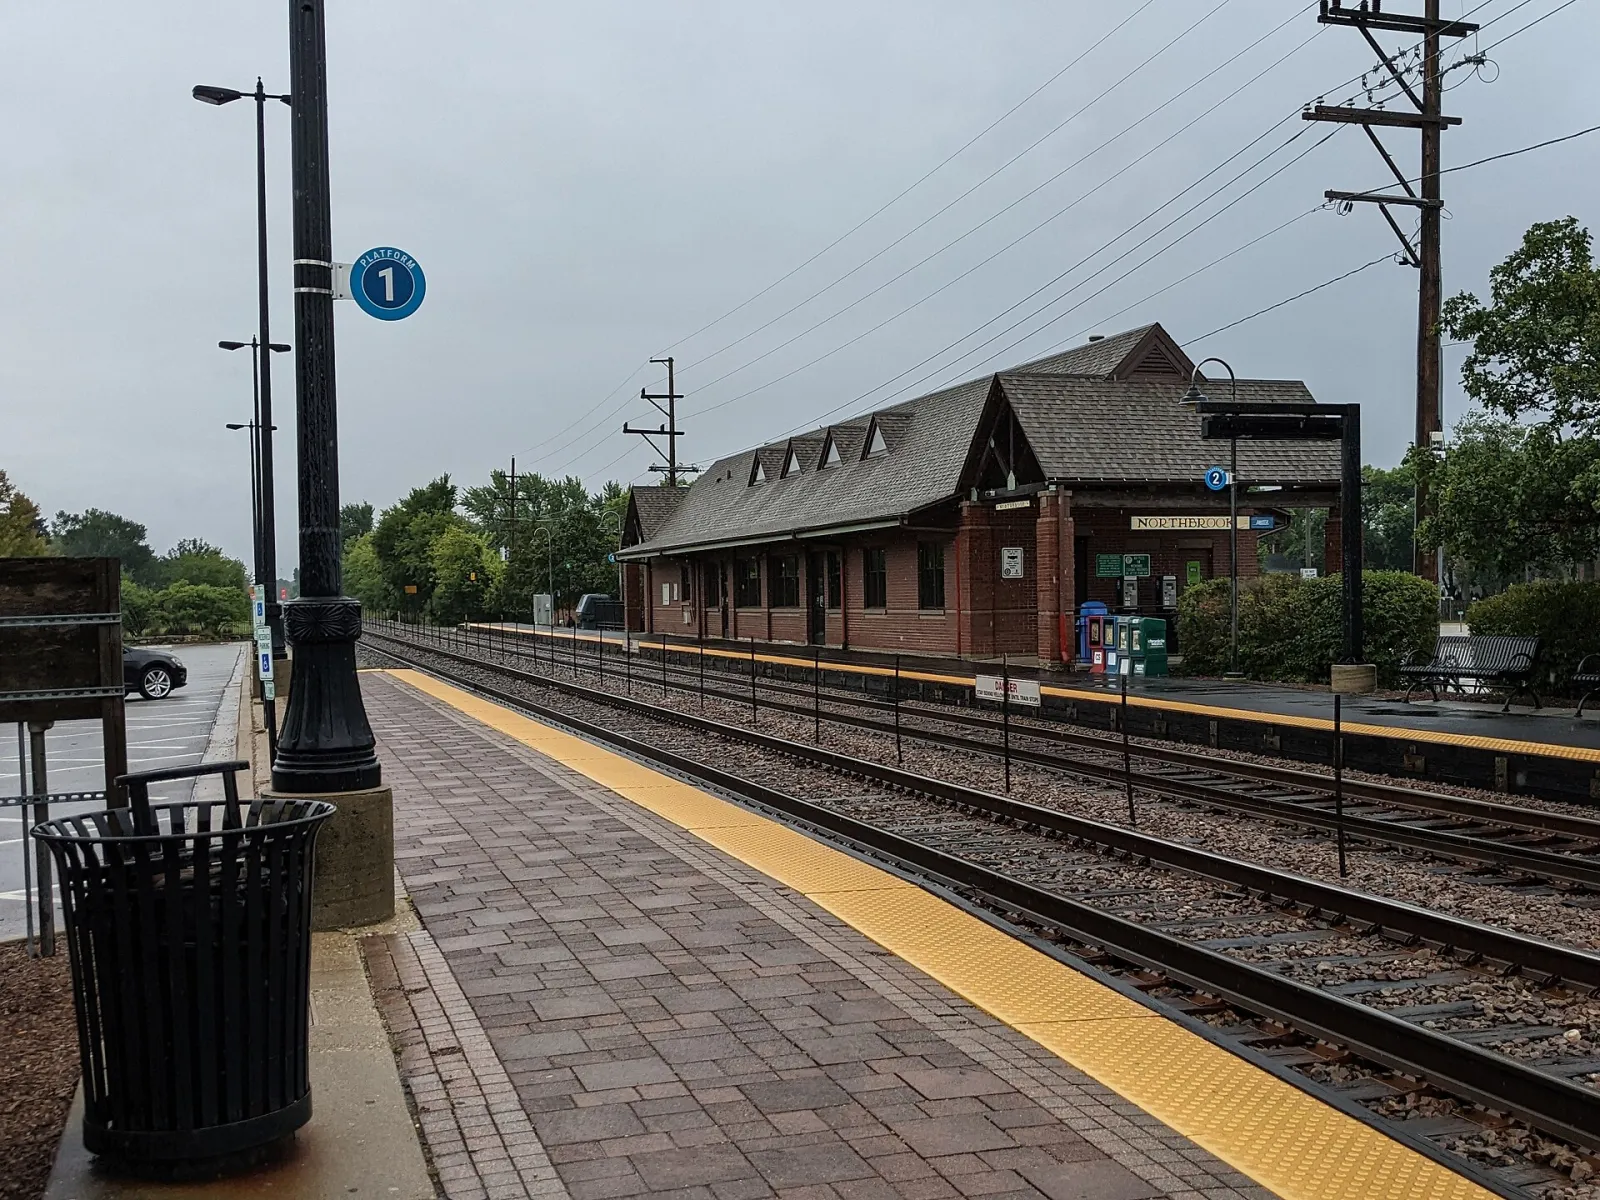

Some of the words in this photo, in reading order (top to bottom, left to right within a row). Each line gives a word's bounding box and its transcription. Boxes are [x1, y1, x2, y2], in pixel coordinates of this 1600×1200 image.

[360, 249, 416, 270] PLATFORM
[378, 267, 394, 302] 1
[1212, 472, 1220, 485] 2
